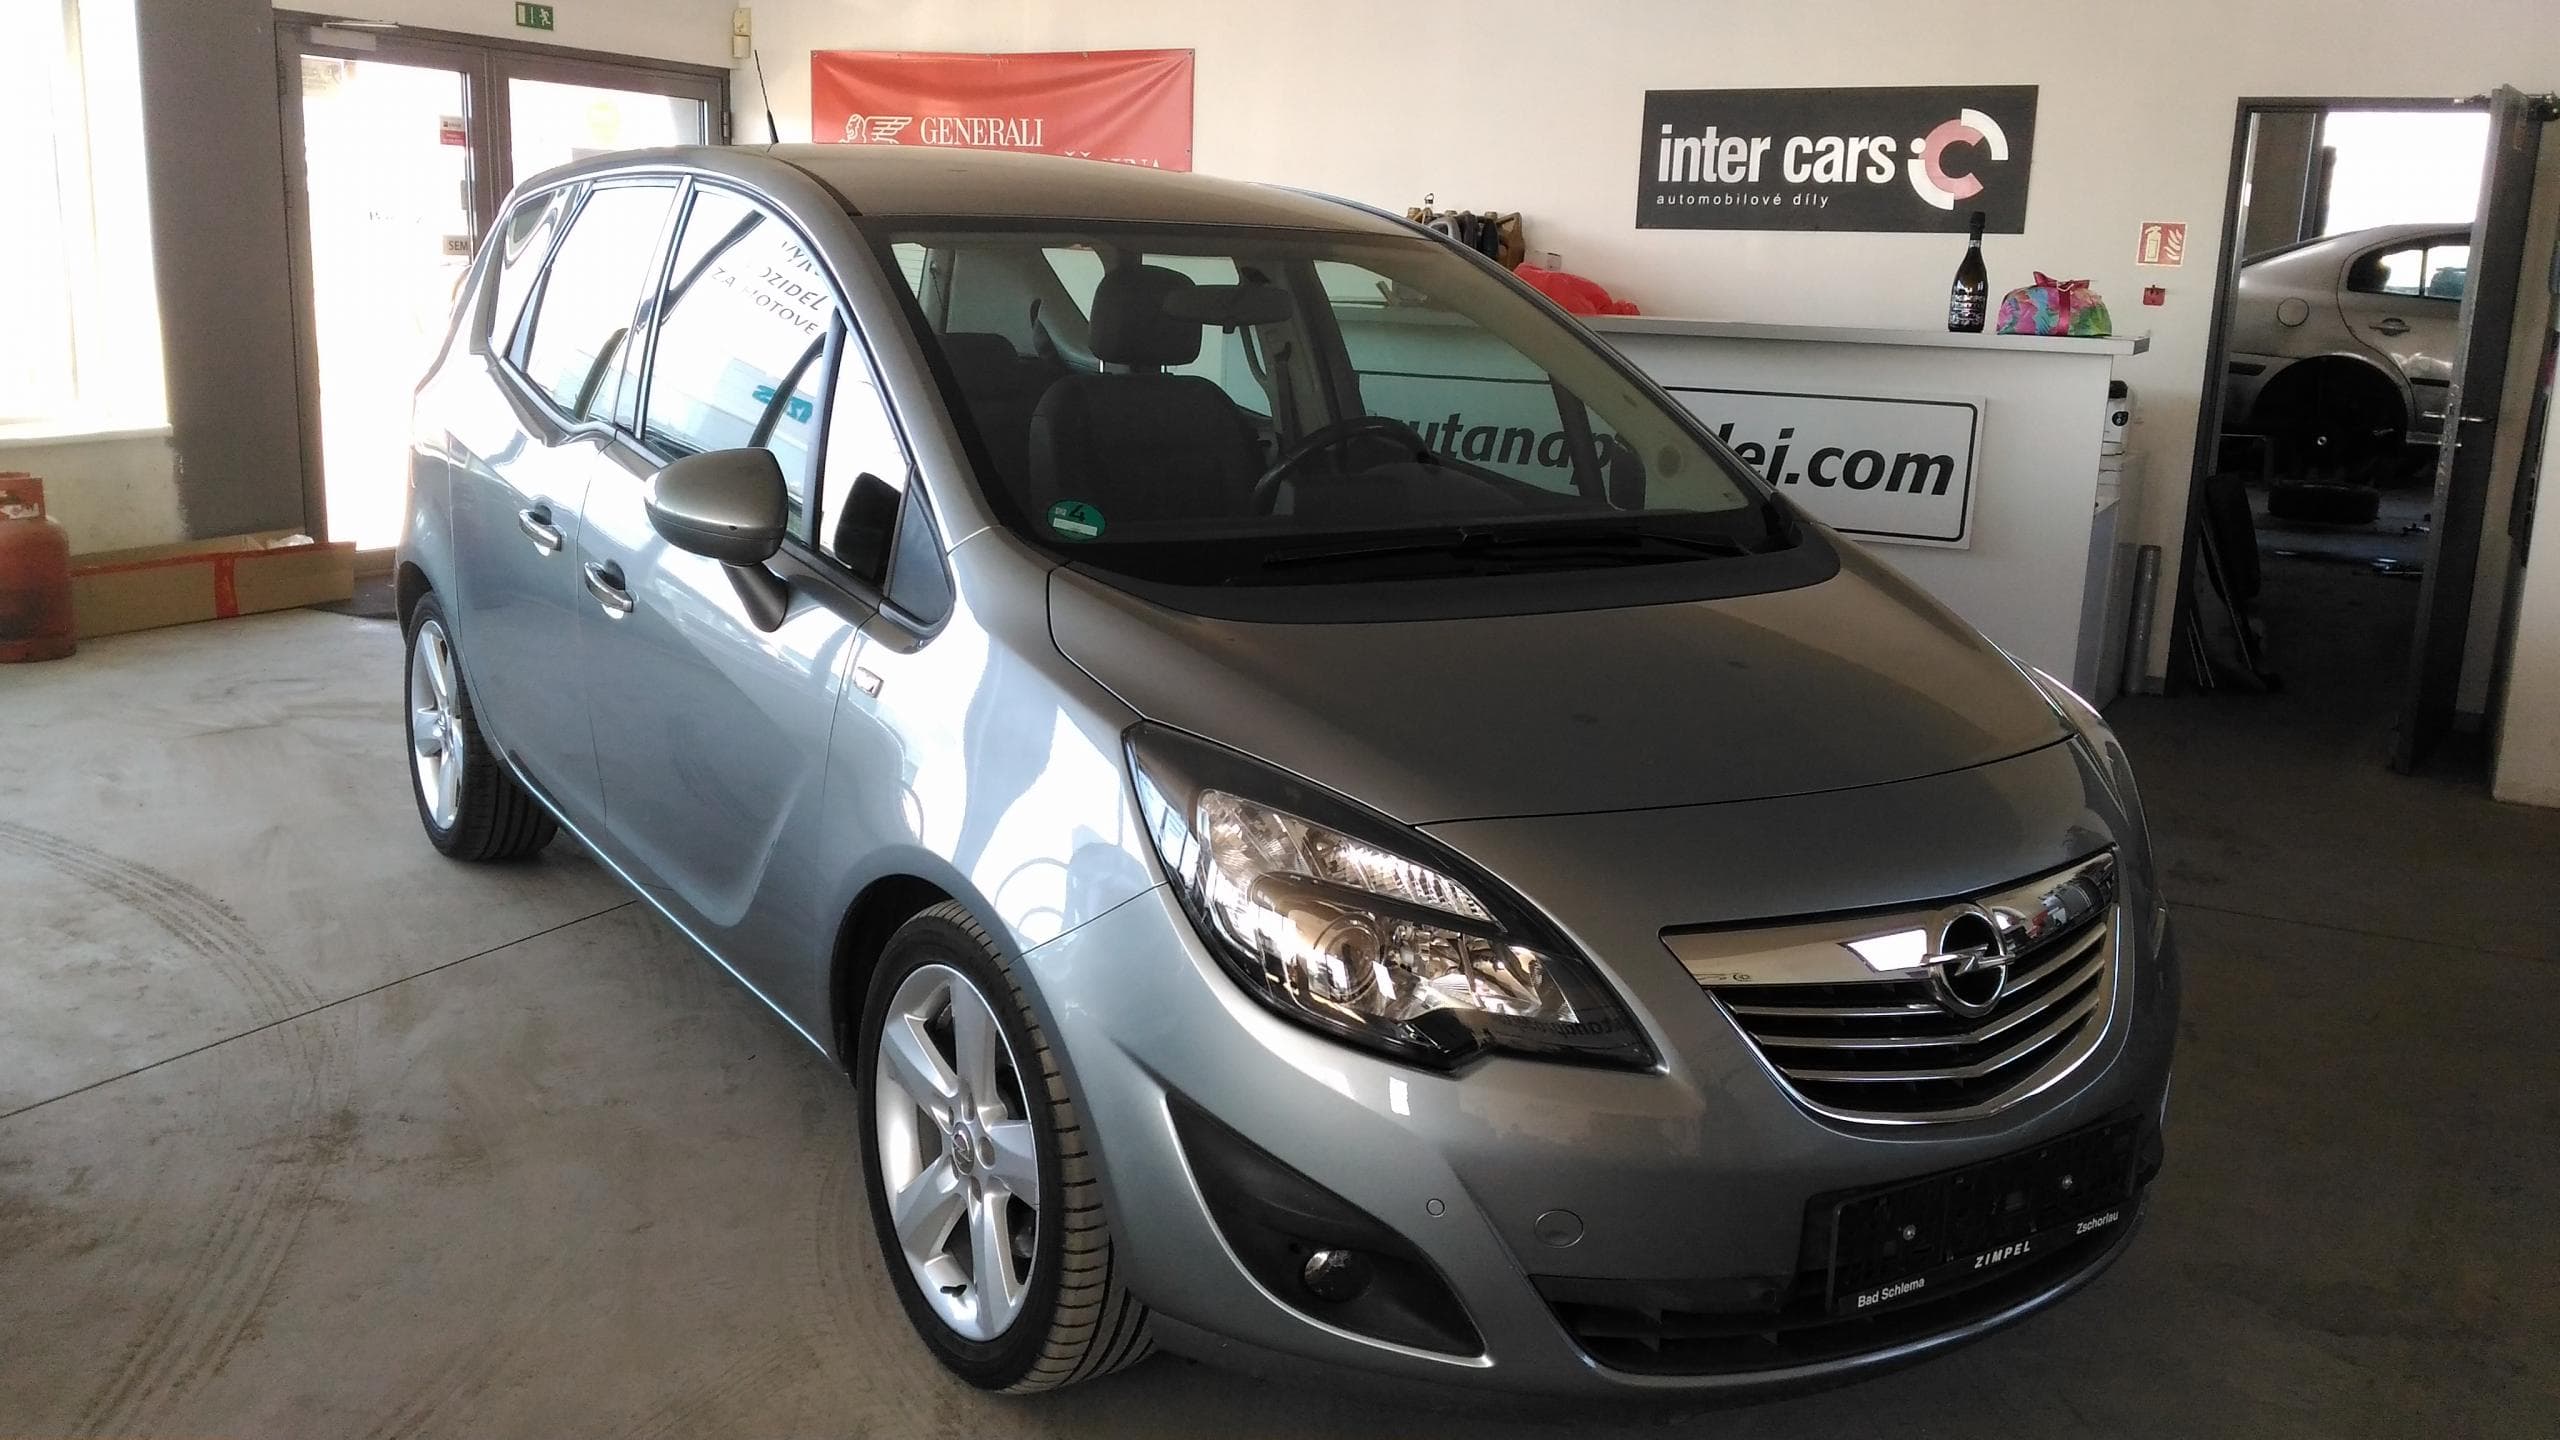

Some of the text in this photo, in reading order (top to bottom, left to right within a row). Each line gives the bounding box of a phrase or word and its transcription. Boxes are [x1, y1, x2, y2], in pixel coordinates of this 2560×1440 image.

[919, 116, 1044, 147] GENERALI
[1657, 124, 1898, 184] inter cars
[1656, 192, 1830, 209] automobilové díly
[2075, 1211, 2119, 1235] Zschorlau
[1973, 1240, 2031, 1269] ZIMPEL
[1857, 1276, 1925, 1308] Bad Schlema
